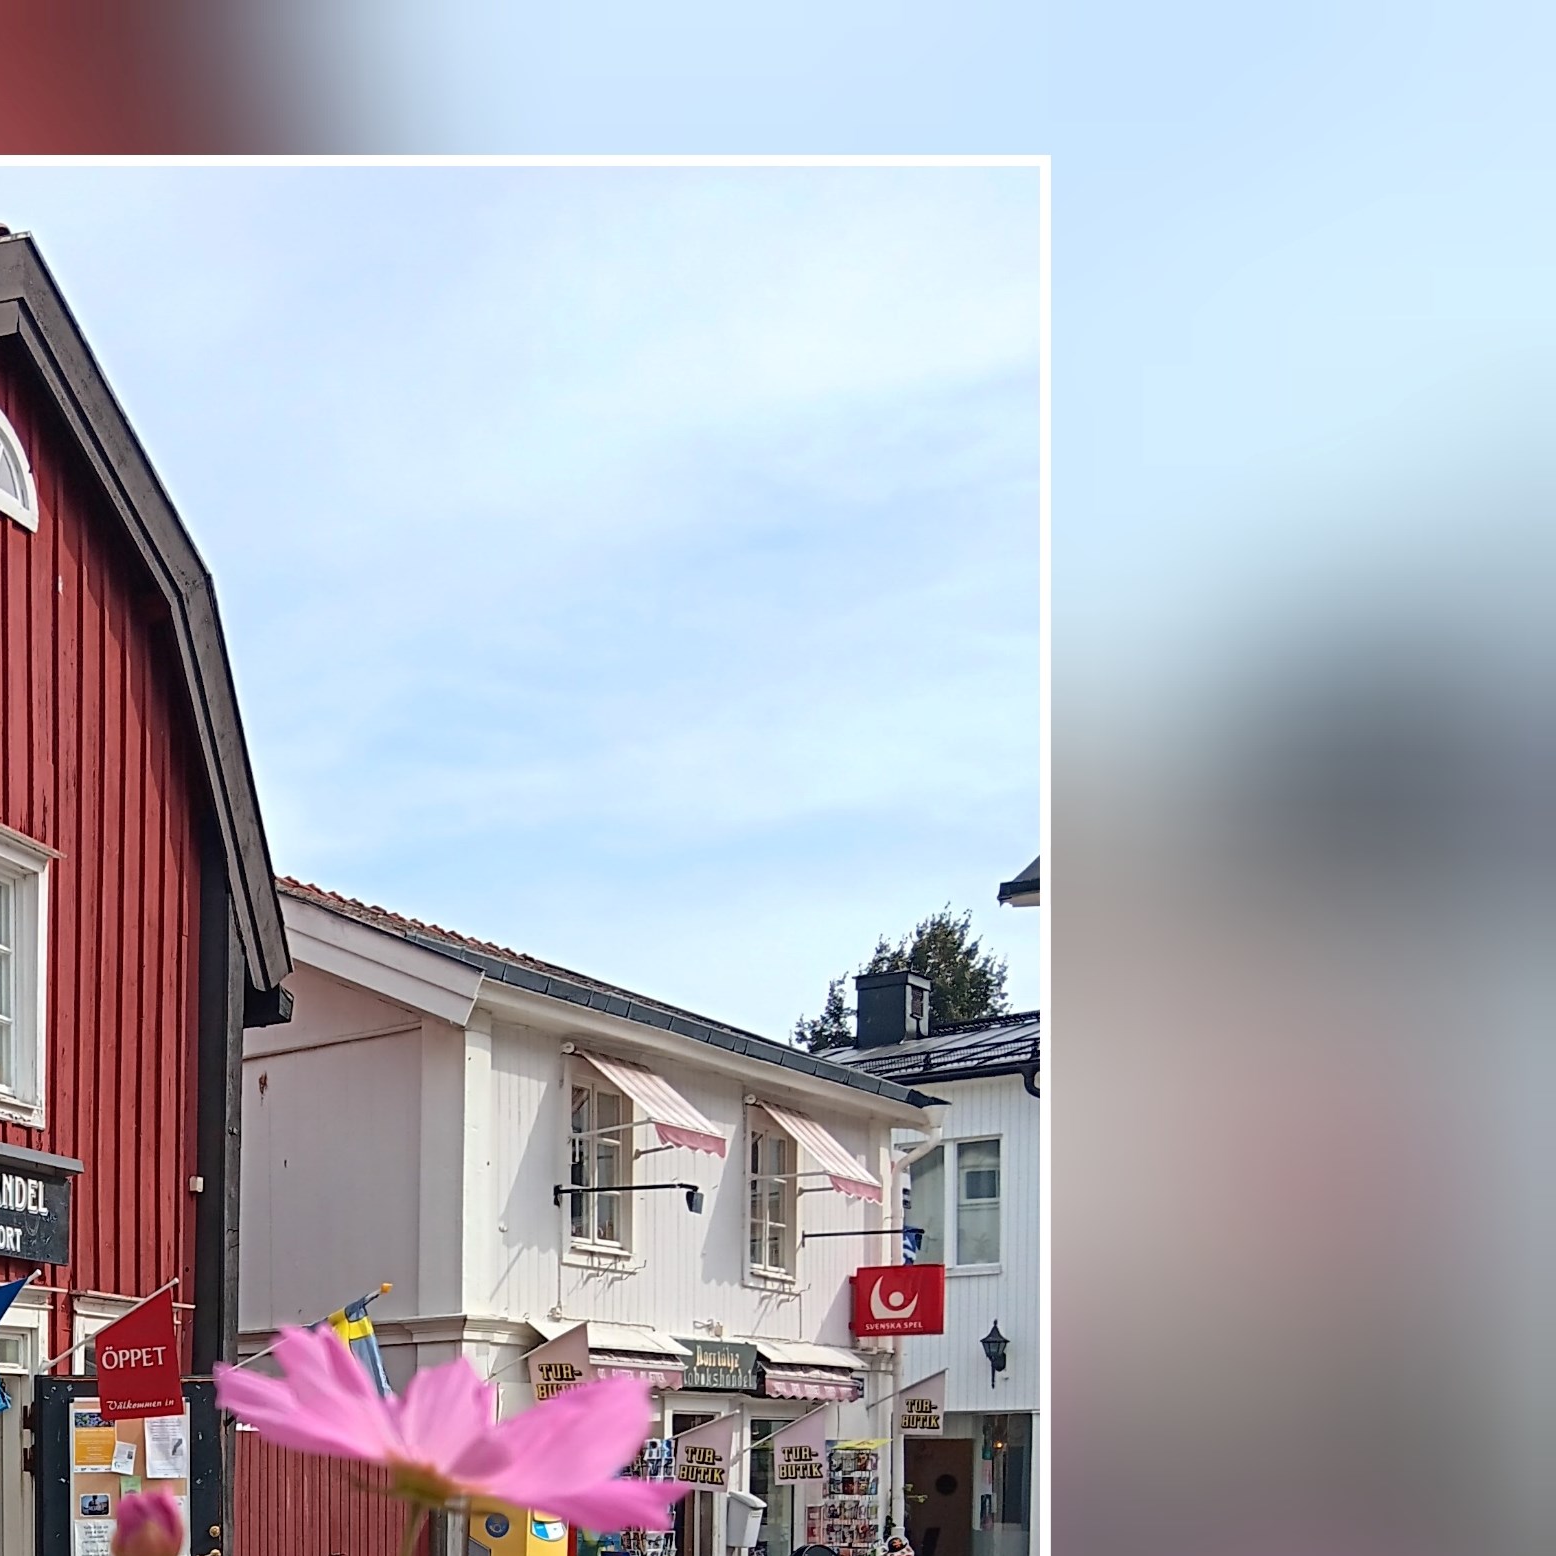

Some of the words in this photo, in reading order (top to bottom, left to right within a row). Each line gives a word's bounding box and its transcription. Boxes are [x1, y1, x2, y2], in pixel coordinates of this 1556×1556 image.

[865, 1322, 902, 1331] SVENSKA
[903, 1321, 923, 1329] SPEL
[101, 1346, 167, 1370] ÖPPET
[106, 1399, 162, 1411] Välkommen
[164, 1398, 174, 1407] in
[901, 1414, 940, 1430] BUTIK
[678, 1465, 725, 1485] BUTIK
[778, 1463, 823, 1479] BUTIK
